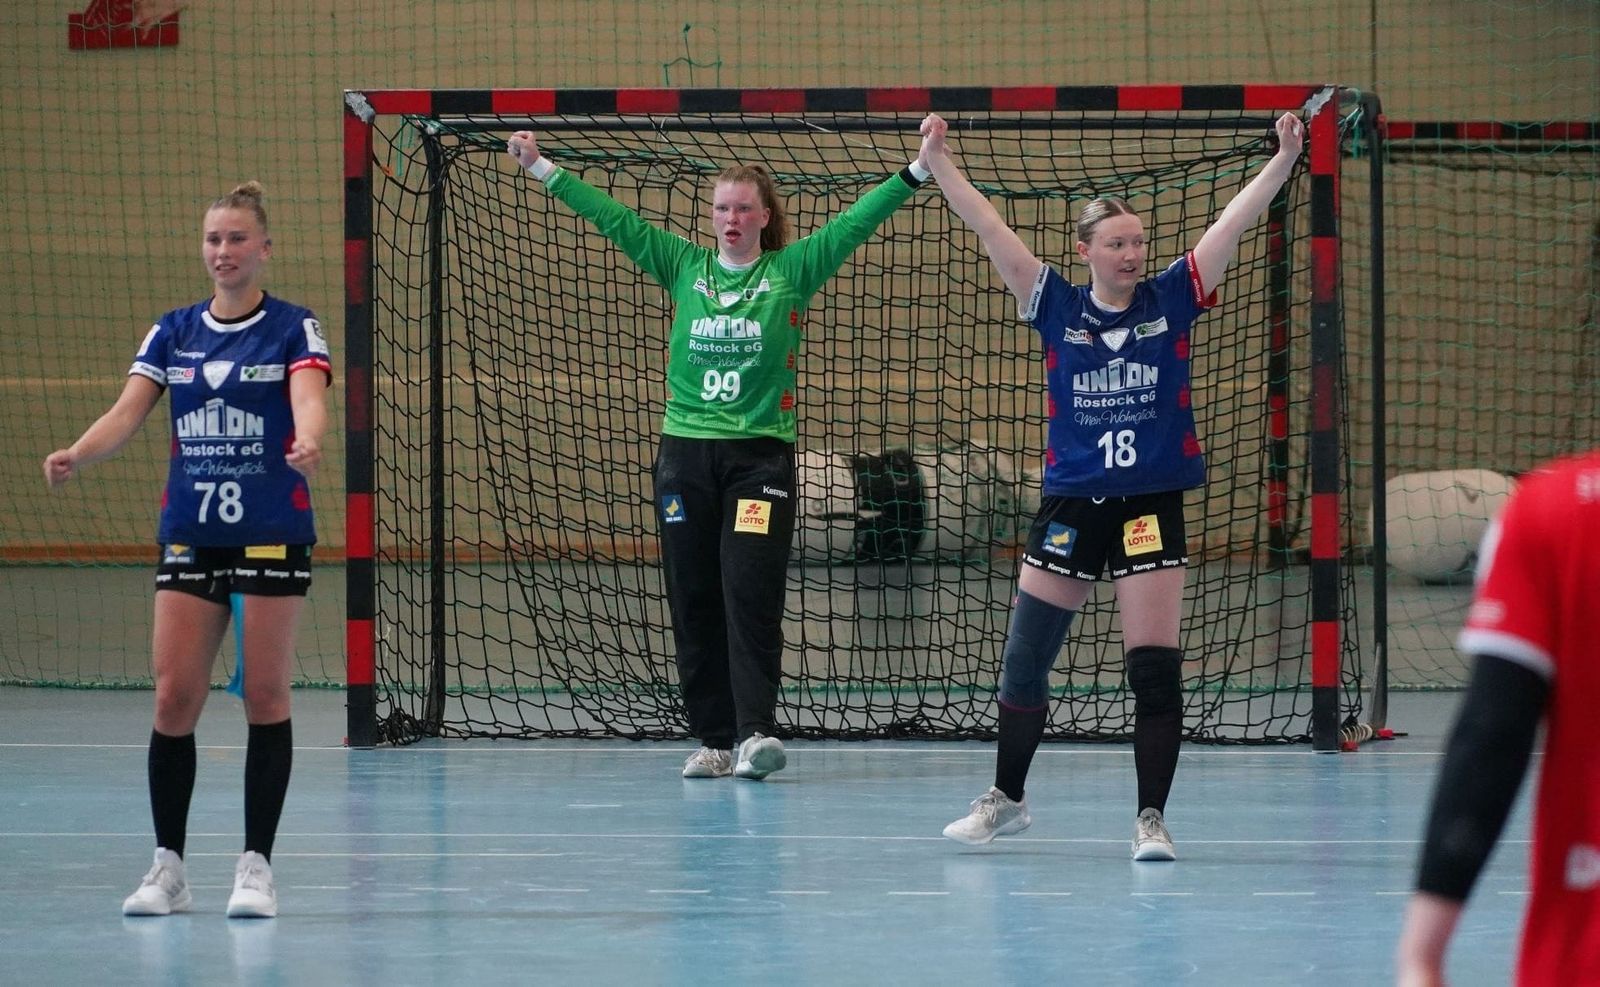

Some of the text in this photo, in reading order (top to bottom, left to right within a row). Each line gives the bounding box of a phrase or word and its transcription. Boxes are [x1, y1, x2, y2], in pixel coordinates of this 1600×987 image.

[690, 314, 762, 338] UNION
[688, 339, 763, 353] Rostock eG
[1073, 357, 1159, 392] UNION
[701, 369, 741, 402] 99
[1073, 390, 1156, 408] Rostock eG
[177, 397, 264, 437] UNION
[240, 442, 264, 455] eG
[1097, 429, 1137, 469] 18
[763, 485, 788, 499] Kempa
[194, 481, 244, 523] 78
[740, 516, 765, 525] LOTTO
[1128, 534, 1156, 546] LOTTO
[1048, 562, 1071, 576] Kempa
[1133, 562, 1156, 573] Kempa
